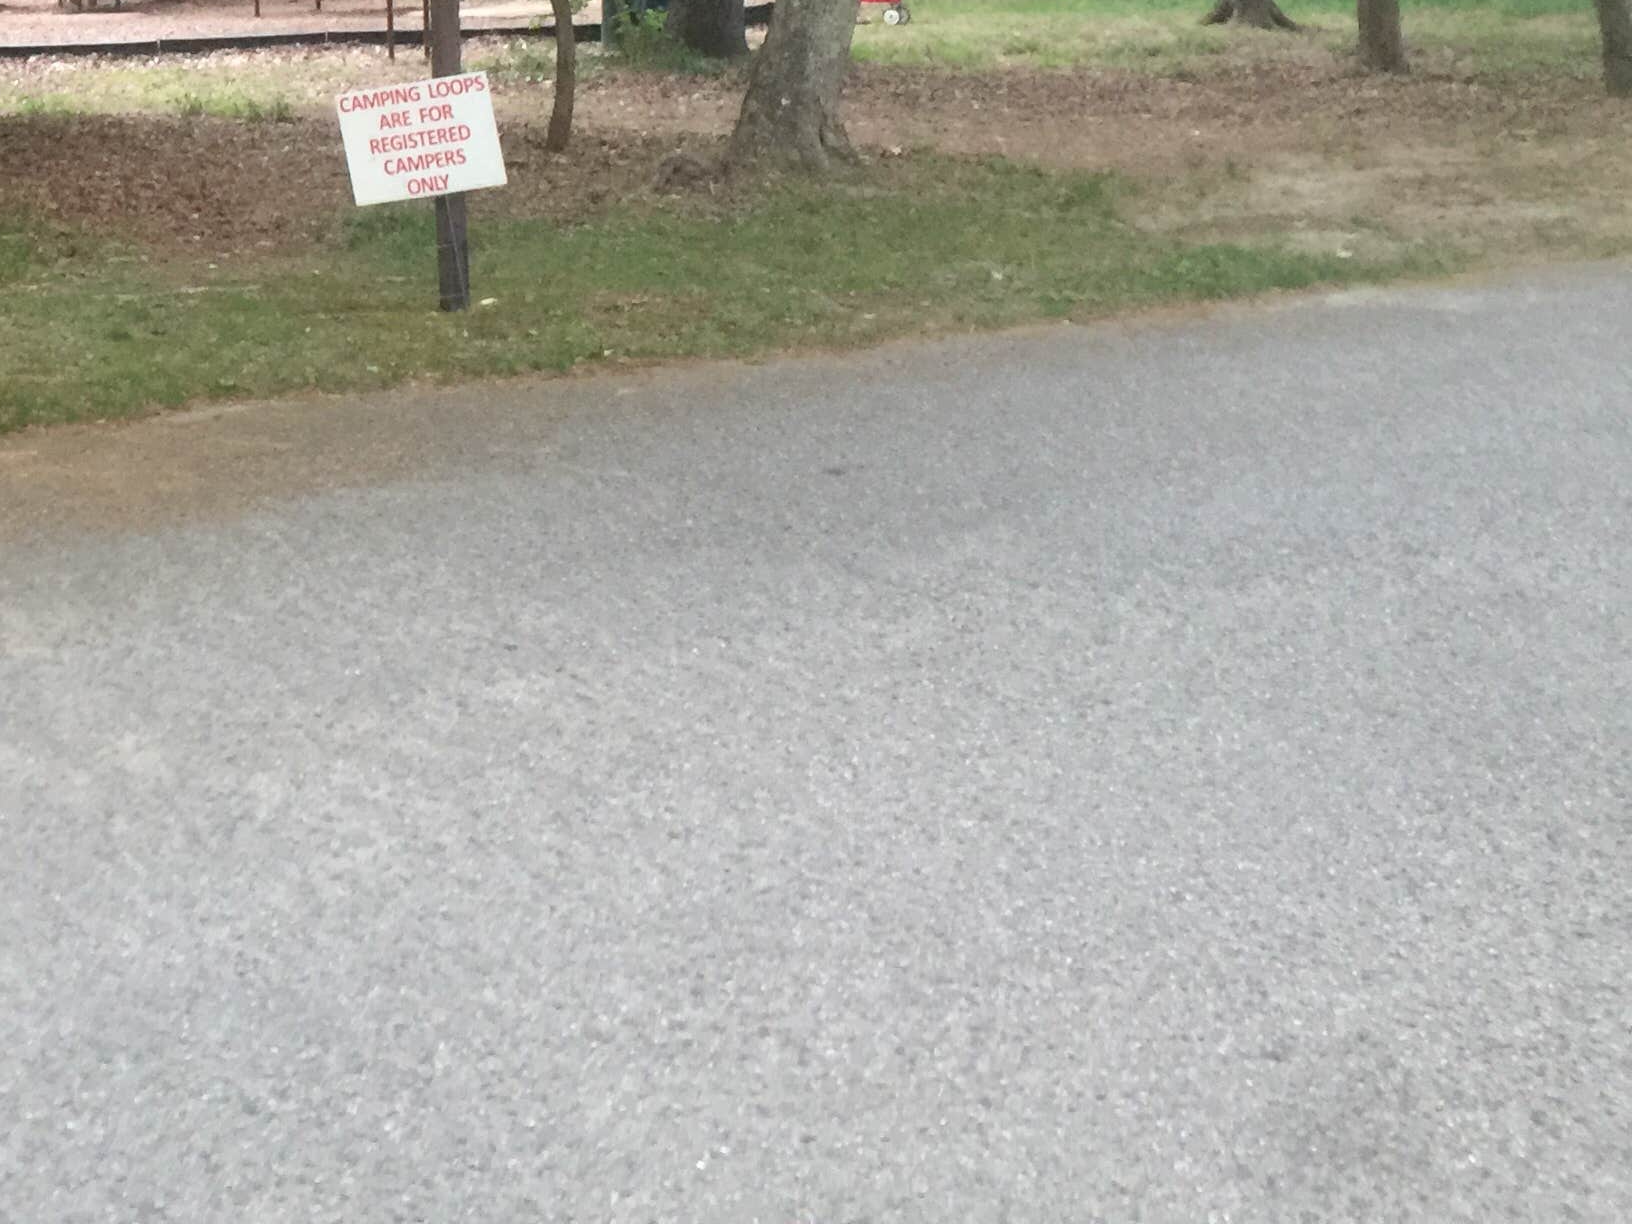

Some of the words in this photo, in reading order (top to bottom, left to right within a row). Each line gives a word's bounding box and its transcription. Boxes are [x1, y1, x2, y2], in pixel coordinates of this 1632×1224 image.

[339, 86, 421, 113] CAMPING
[428, 75, 486, 99] LOOPS
[379, 110, 412, 130] ARE
[419, 104, 454, 124] FOR
[369, 125, 471, 155] REGISTERED
[384, 148, 467, 176] CAMPERS
[407, 174, 450, 196] ONLY
